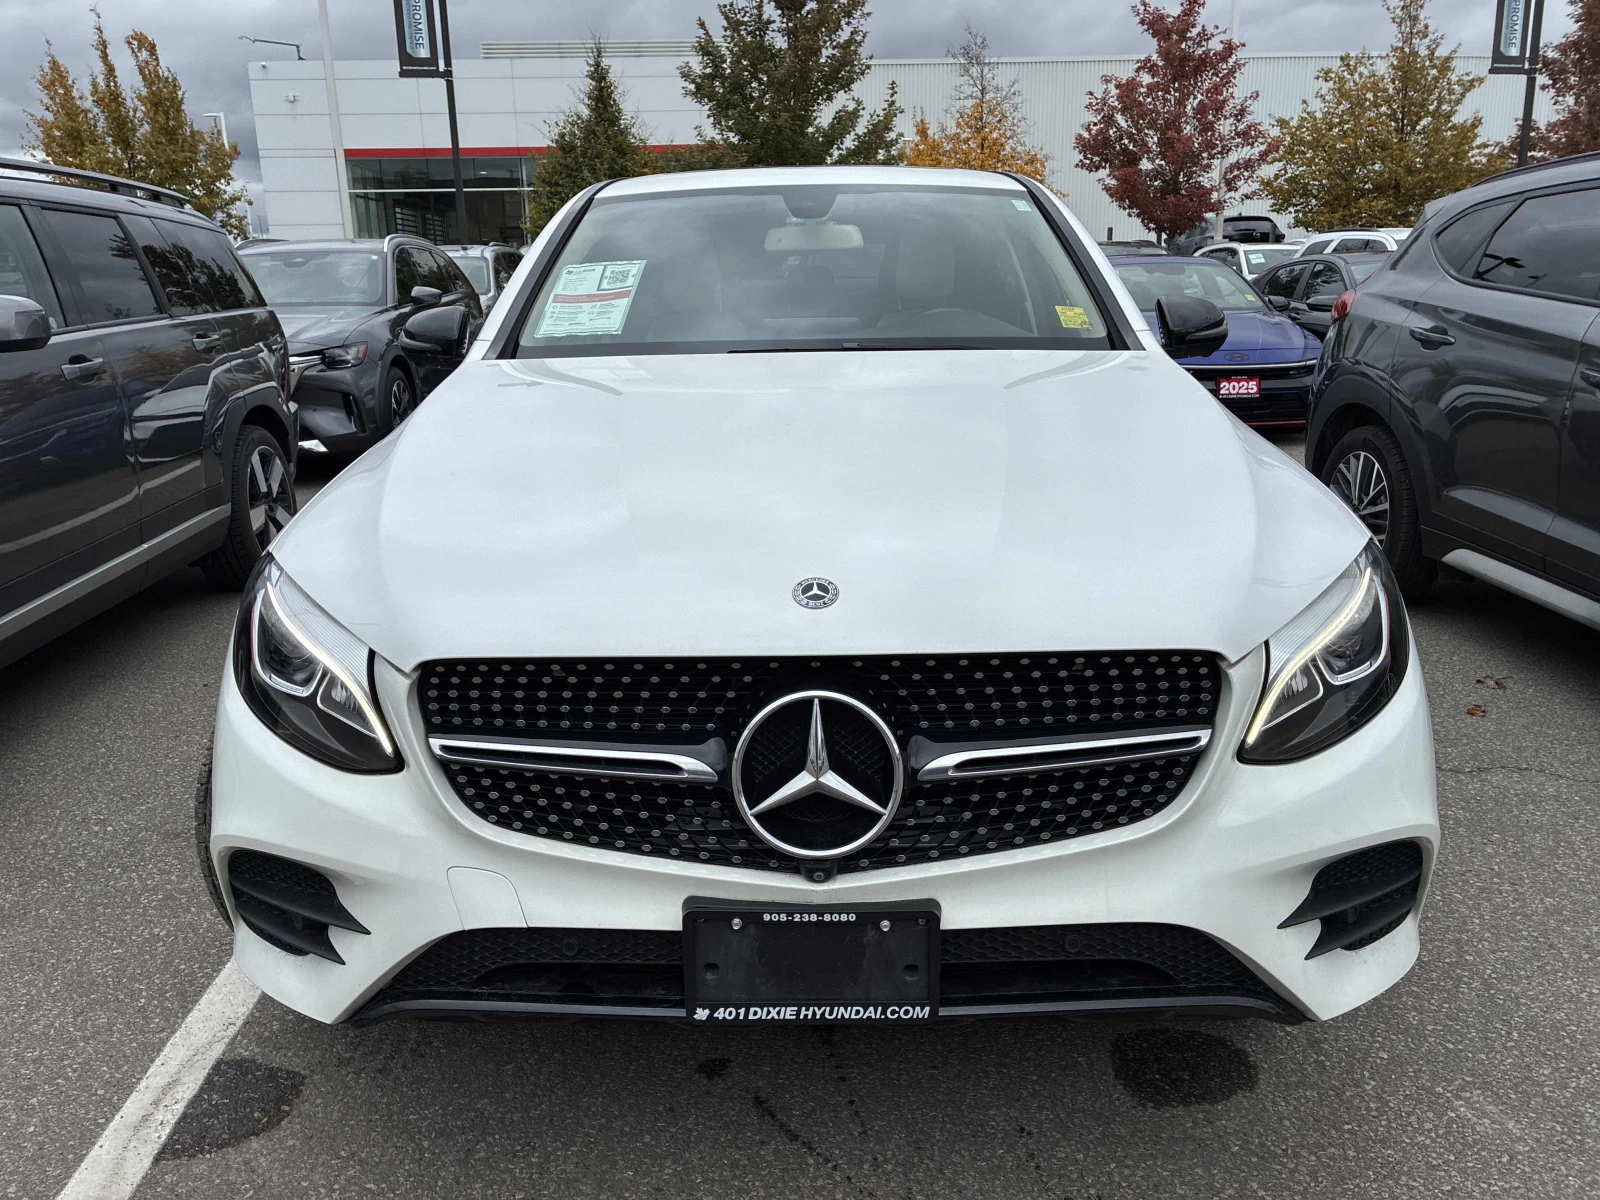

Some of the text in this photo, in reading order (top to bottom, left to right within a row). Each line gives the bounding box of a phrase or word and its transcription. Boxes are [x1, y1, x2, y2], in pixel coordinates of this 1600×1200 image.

[1508, 0, 1521, 48] PROMISE
[1220, 381, 1258, 394] 2025
[763, 913, 856, 921] 905-238-8080
